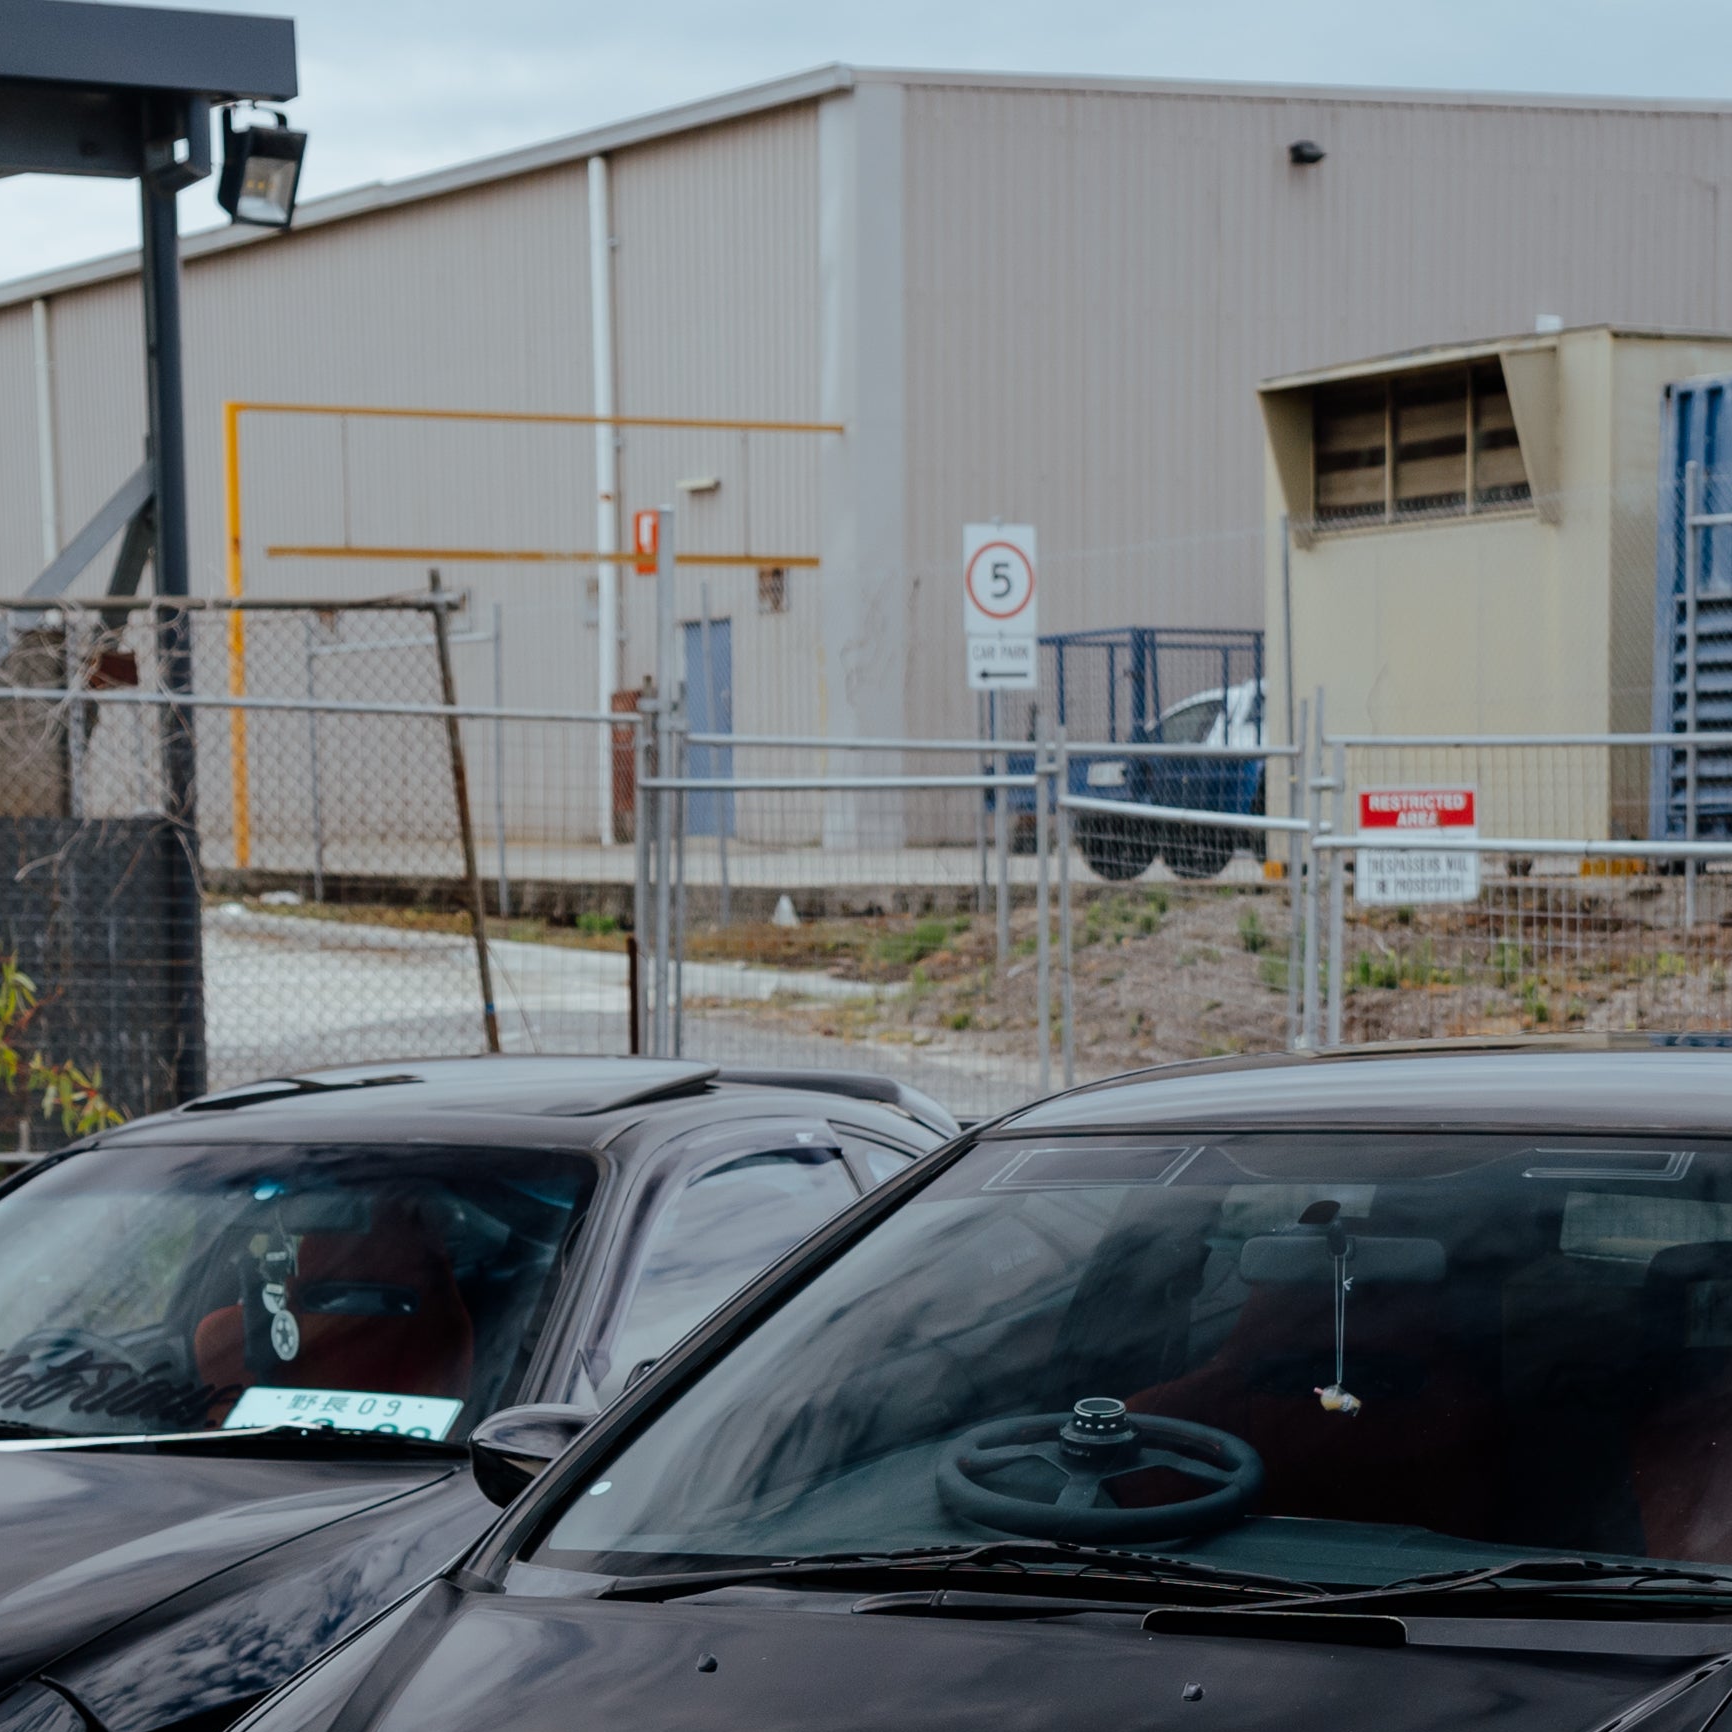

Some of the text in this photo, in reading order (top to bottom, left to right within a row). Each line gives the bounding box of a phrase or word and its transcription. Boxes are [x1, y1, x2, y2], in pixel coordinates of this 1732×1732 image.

[991, 562, 1012, 598] 5
[972, 645, 1029, 661] CAR PARK
[1368, 793, 1467, 812] RESTRICTED
[1396, 811, 1440, 828] AREA
